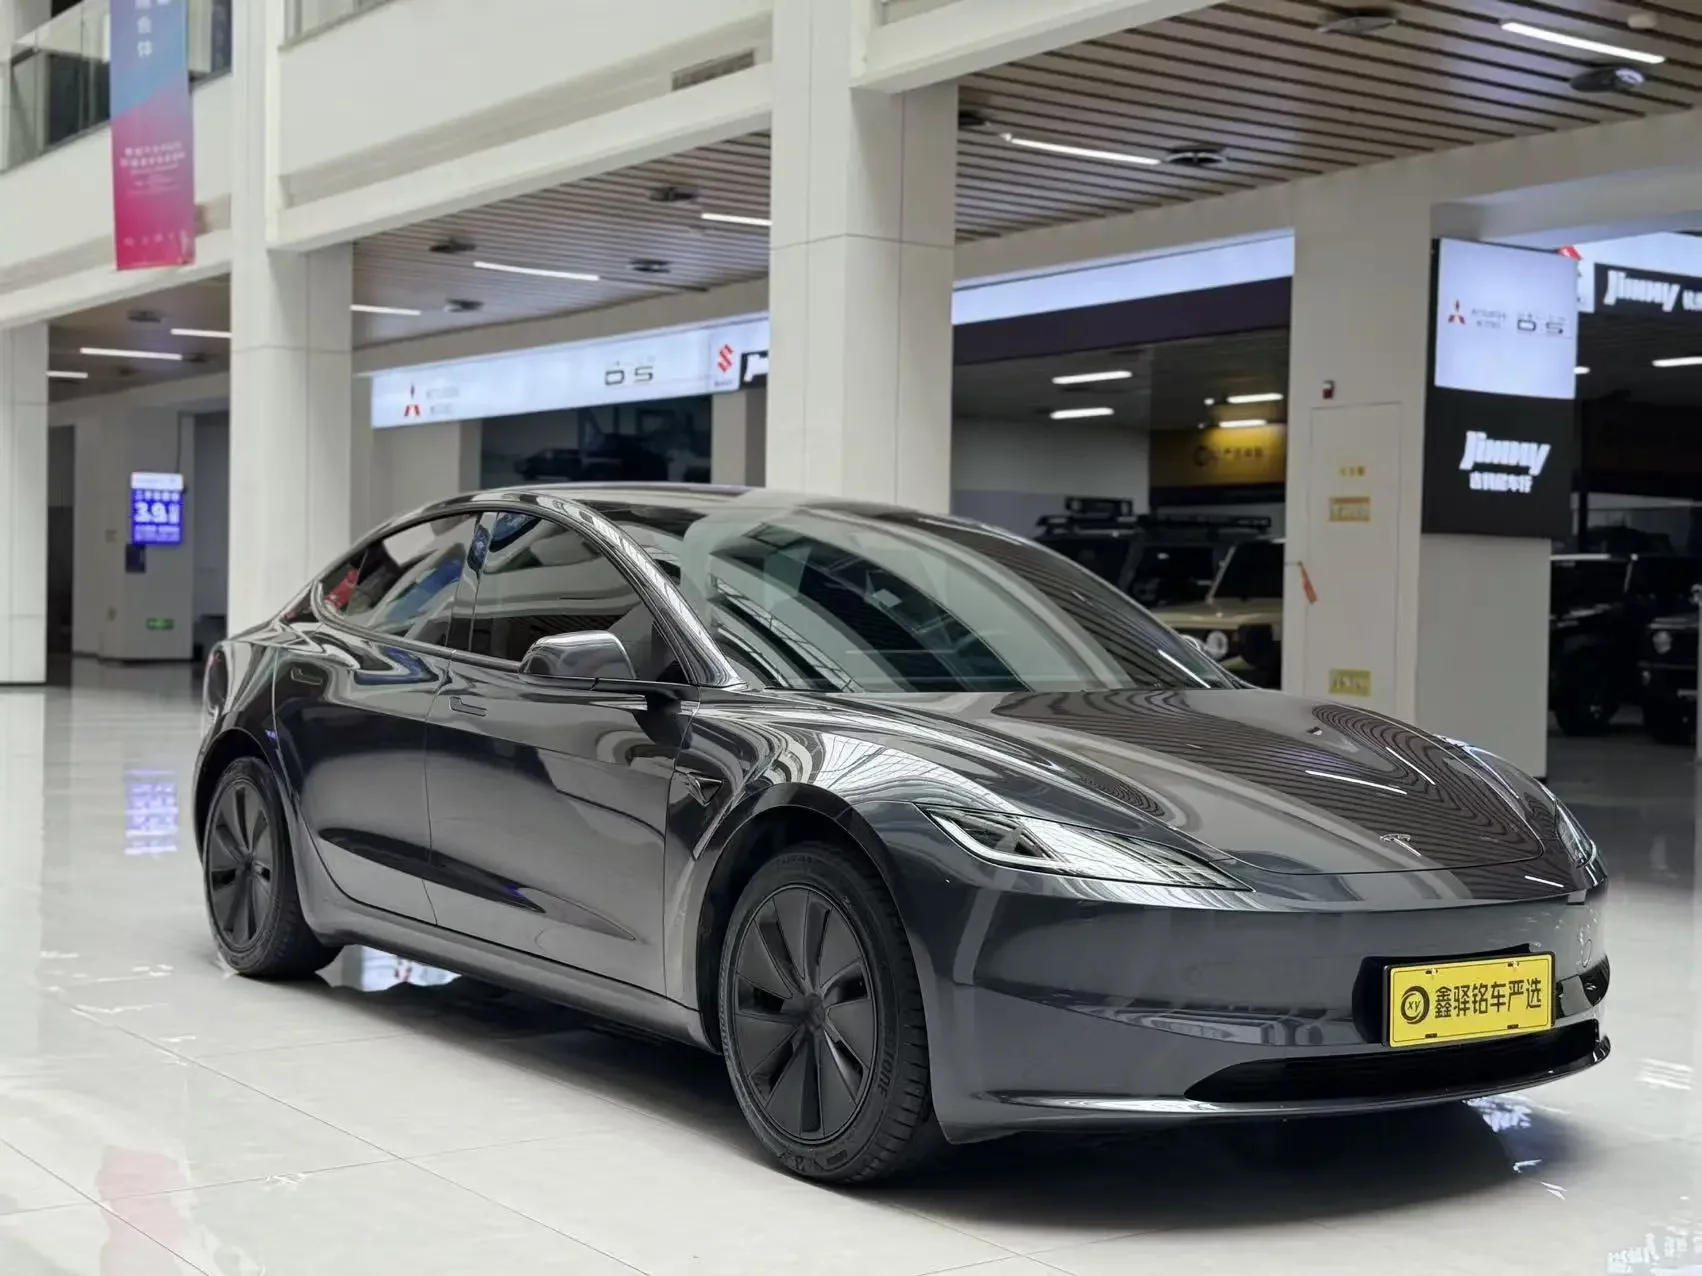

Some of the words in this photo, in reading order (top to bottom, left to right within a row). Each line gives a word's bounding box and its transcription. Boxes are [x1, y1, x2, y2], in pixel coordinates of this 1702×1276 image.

[1435, 978, 1542, 1019] 鑫驿铭车严选
